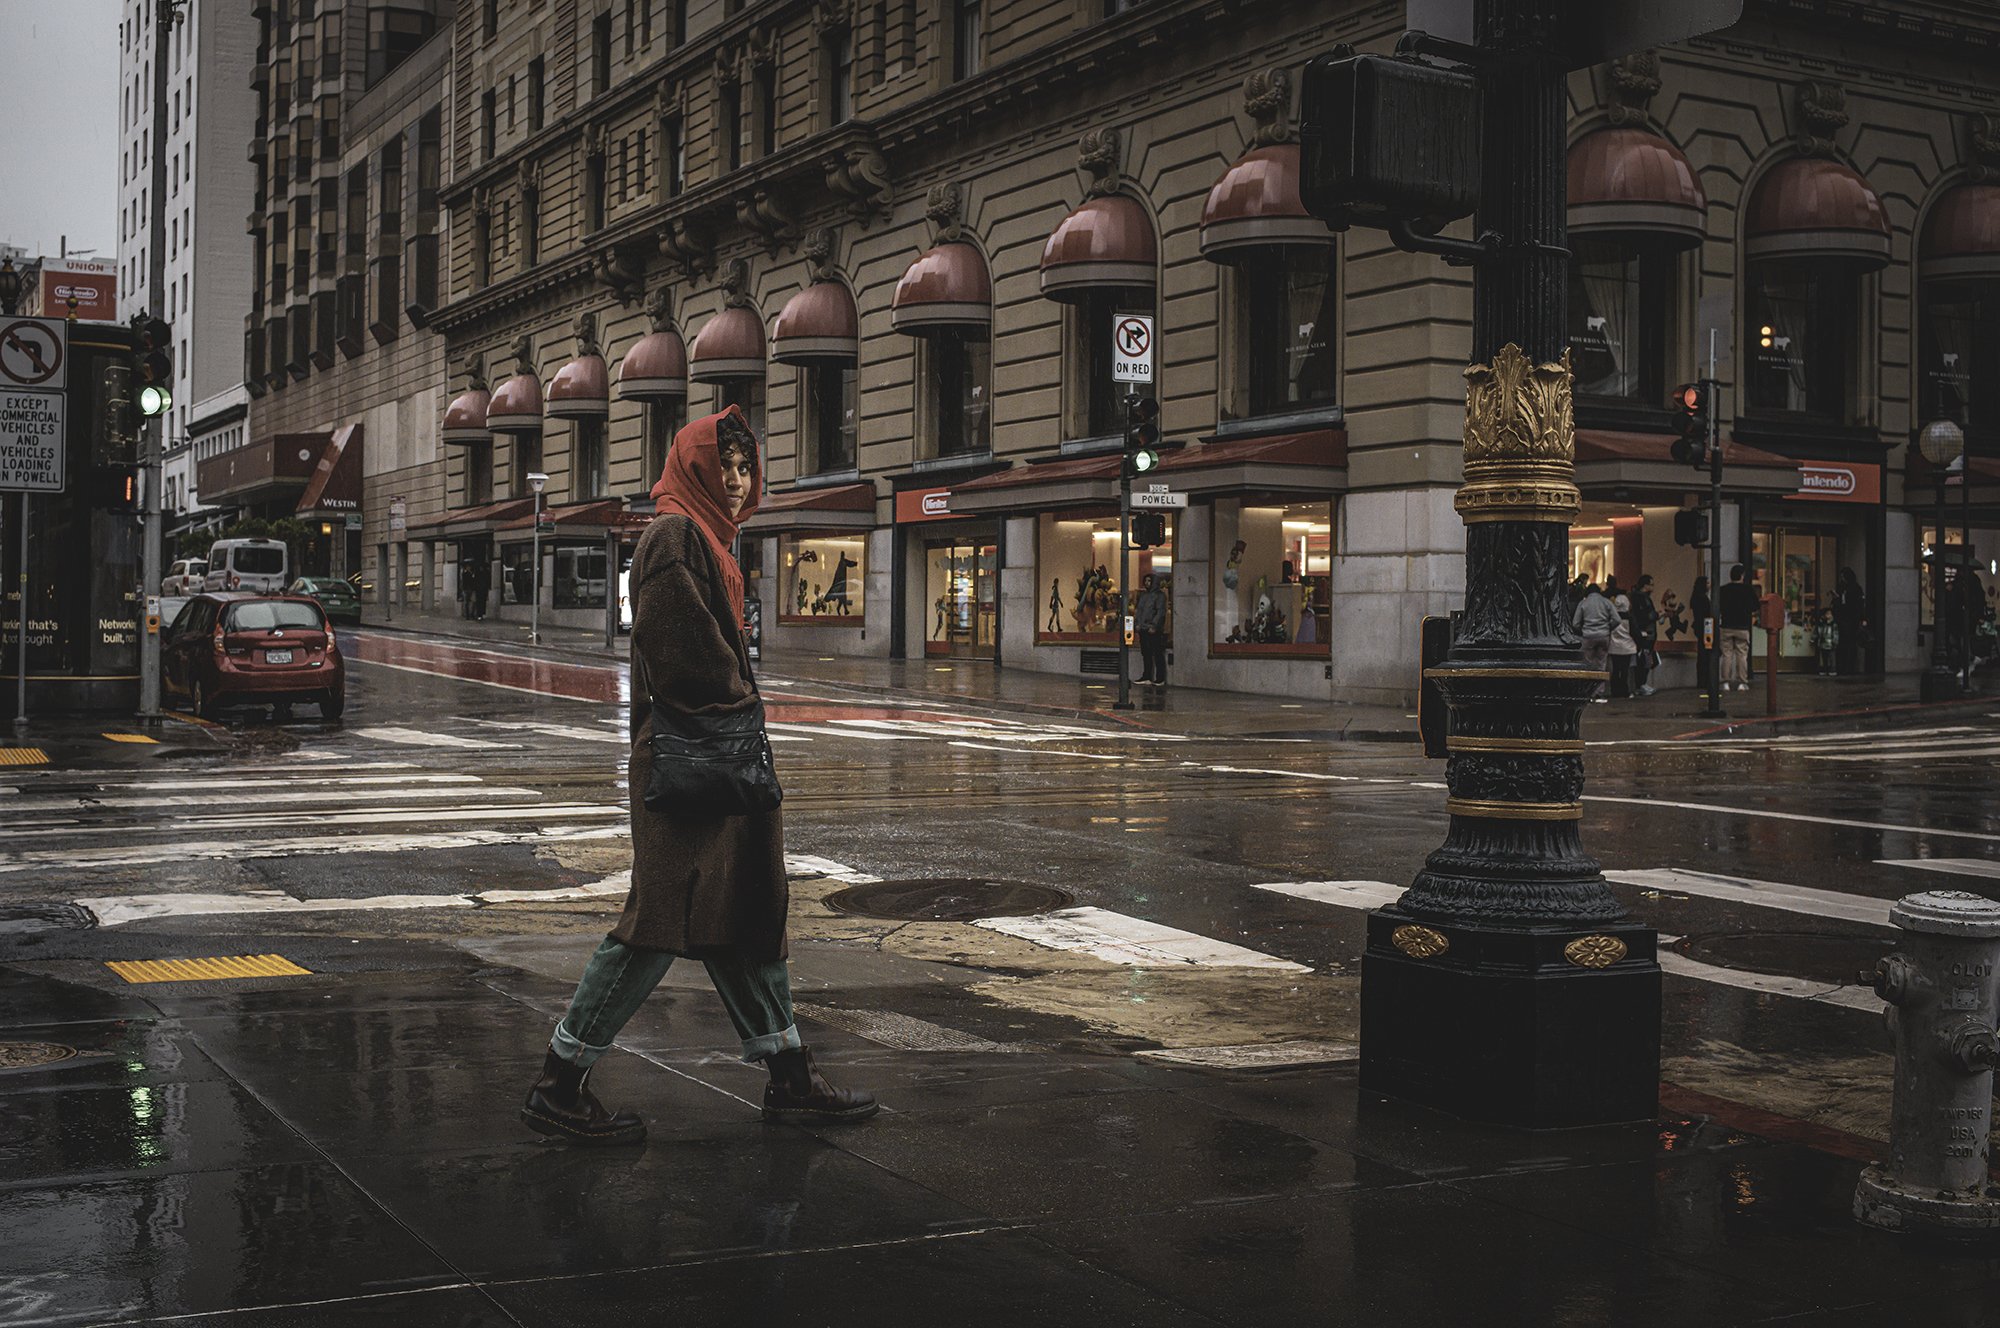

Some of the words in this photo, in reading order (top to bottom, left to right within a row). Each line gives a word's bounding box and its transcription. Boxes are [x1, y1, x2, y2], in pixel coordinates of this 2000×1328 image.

[66, 262, 104, 272] UNION
[1116, 362, 1129, 373] ON
[1132, 363, 1150, 374] RED
[6, 397, 49, 410] EXCEPT
[1, 422, 55, 436] VEHICLES
[16, 434, 39, 447] AND
[0, 446, 55, 460] VEHICLES
[2, 459, 52, 472] LOADING
[0, 471, 9, 482] N
[15, 471, 59, 484] POWELL
[1803, 473, 1849, 488] intendo
[322, 498, 357, 508] WESTIN
[1141, 495, 1176, 505] POWELL
[28, 619, 58, 631] that's
[25, 633, 53, 647] ought
[1951, 1126, 1977, 1140] USA
